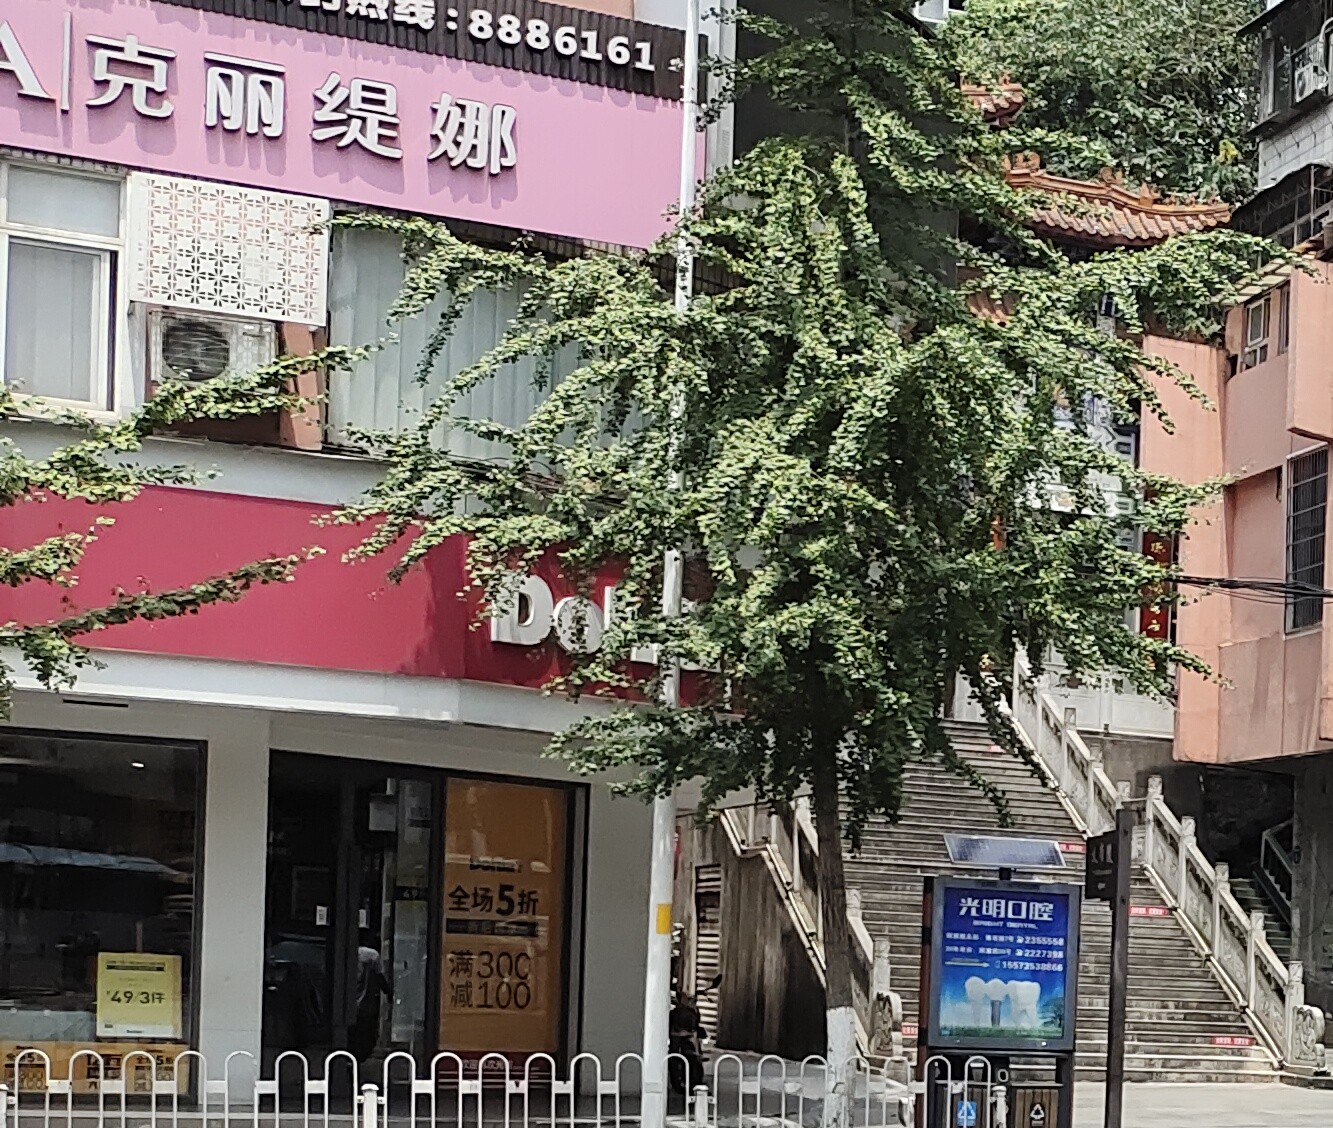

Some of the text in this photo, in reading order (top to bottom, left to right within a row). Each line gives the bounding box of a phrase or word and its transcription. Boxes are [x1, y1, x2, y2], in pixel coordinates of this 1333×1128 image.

[85, 33, 519, 175] 克丽缇娜
[448, 885, 539, 917] 全场5折
[959, 897, 1054, 921] 光明口腔
[450, 981, 531, 1009] 减100
